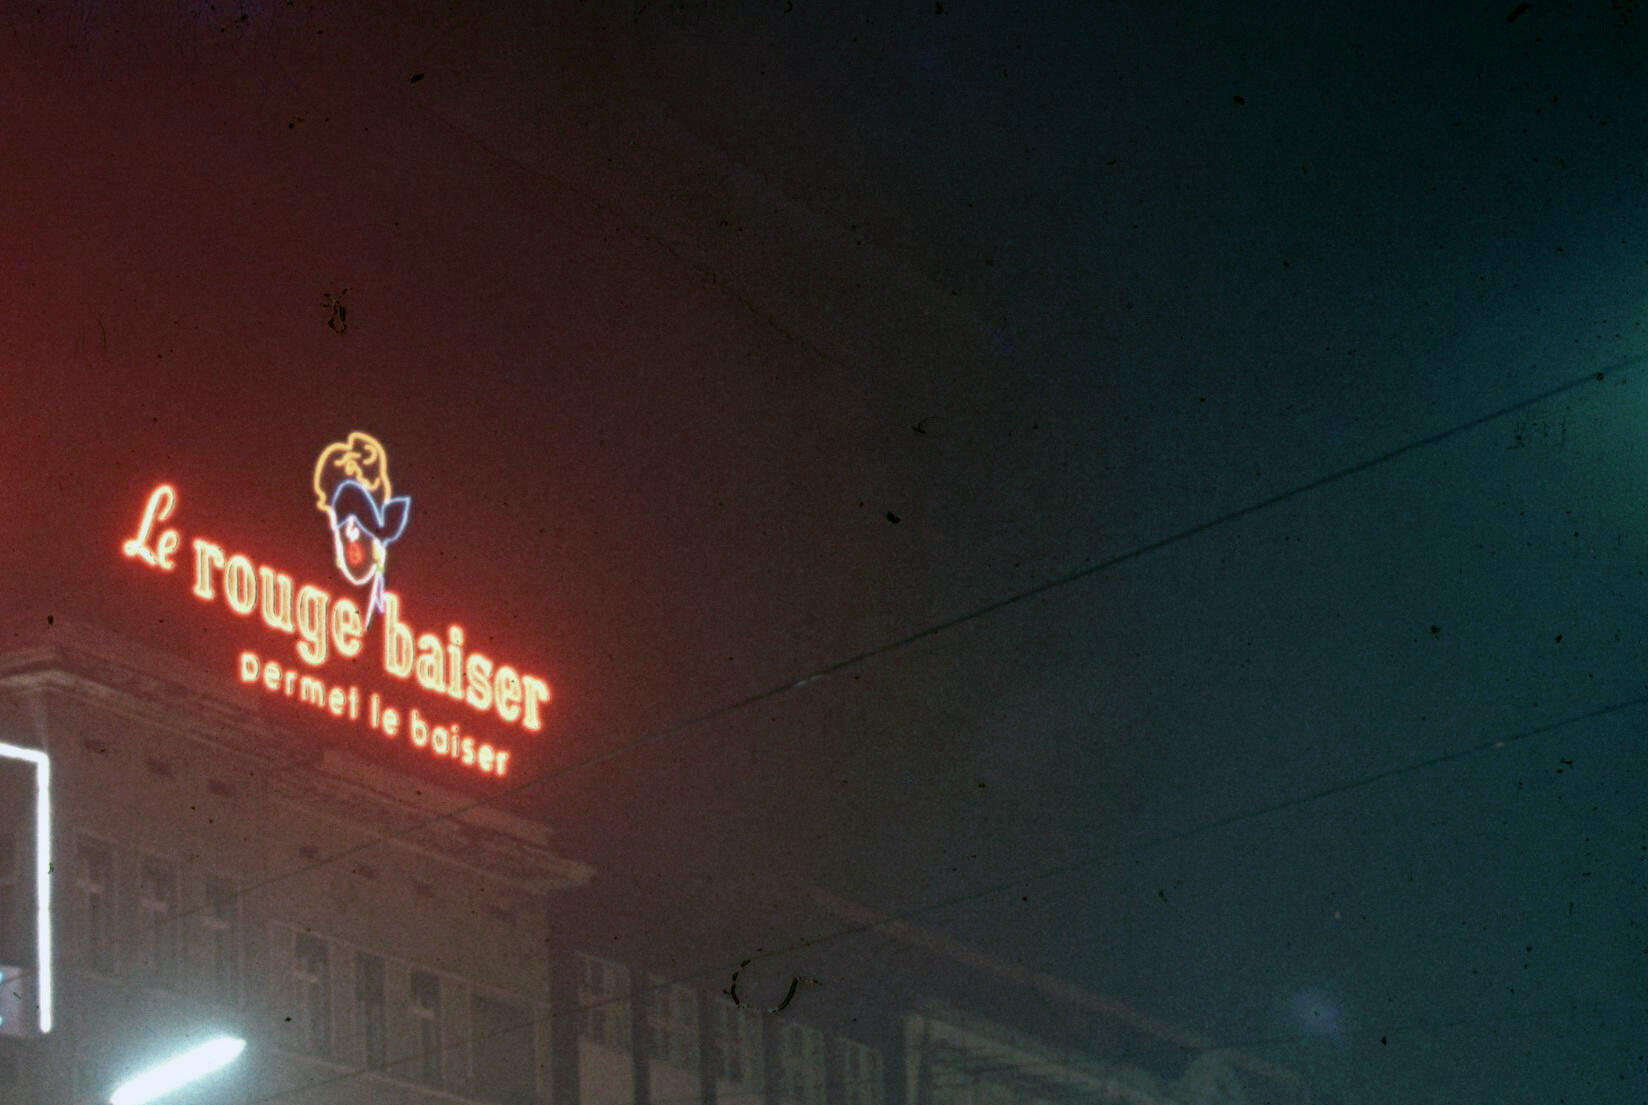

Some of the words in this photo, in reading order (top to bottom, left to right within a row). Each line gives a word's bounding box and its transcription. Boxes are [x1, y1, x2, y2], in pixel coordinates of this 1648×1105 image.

[122, 484, 181, 570] Le
[192, 538, 363, 664] rouge
[383, 591, 551, 730] baiser
[370, 691, 400, 737] le
[410, 708, 511, 776] baiser
